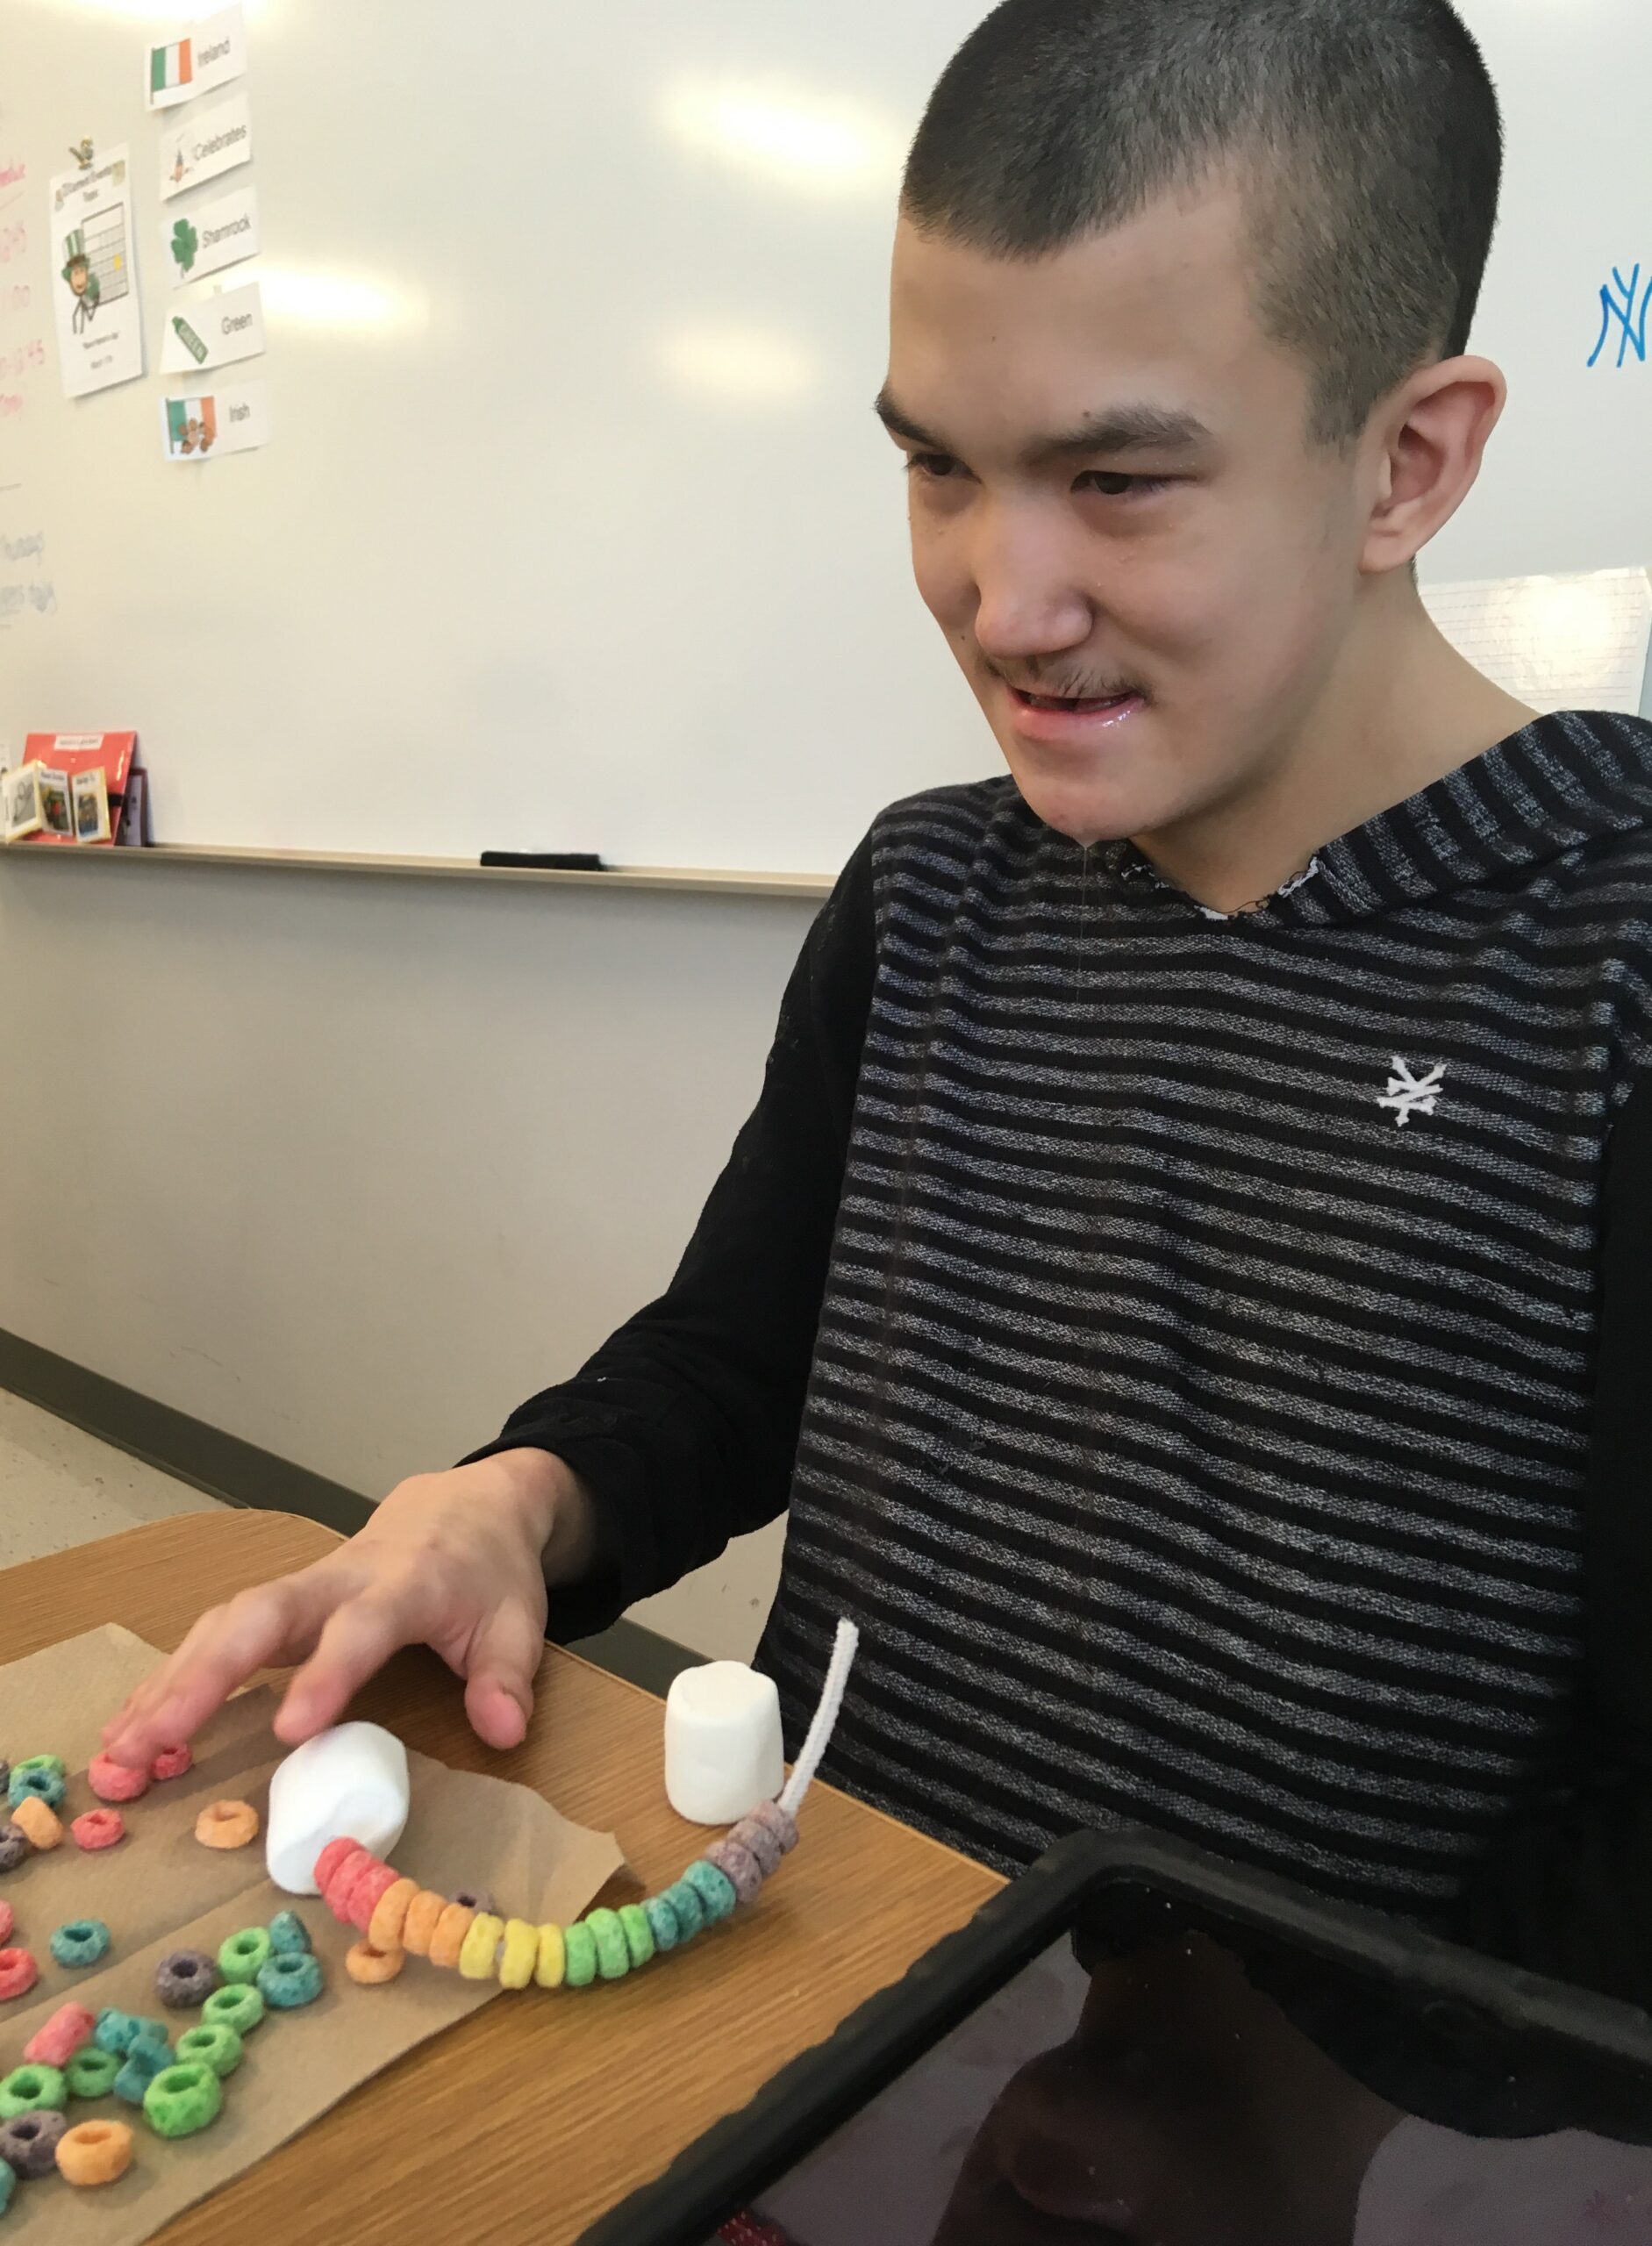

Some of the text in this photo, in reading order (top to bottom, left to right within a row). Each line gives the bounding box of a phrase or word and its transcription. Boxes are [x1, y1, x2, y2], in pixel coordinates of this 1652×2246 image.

[197, 36, 230, 67] Ireland
[195, 125, 247, 161] Celebrates
[203, 212, 252, 248] Shamrock
[222, 313, 253, 335] Green
[229, 403, 250, 423] Irish
